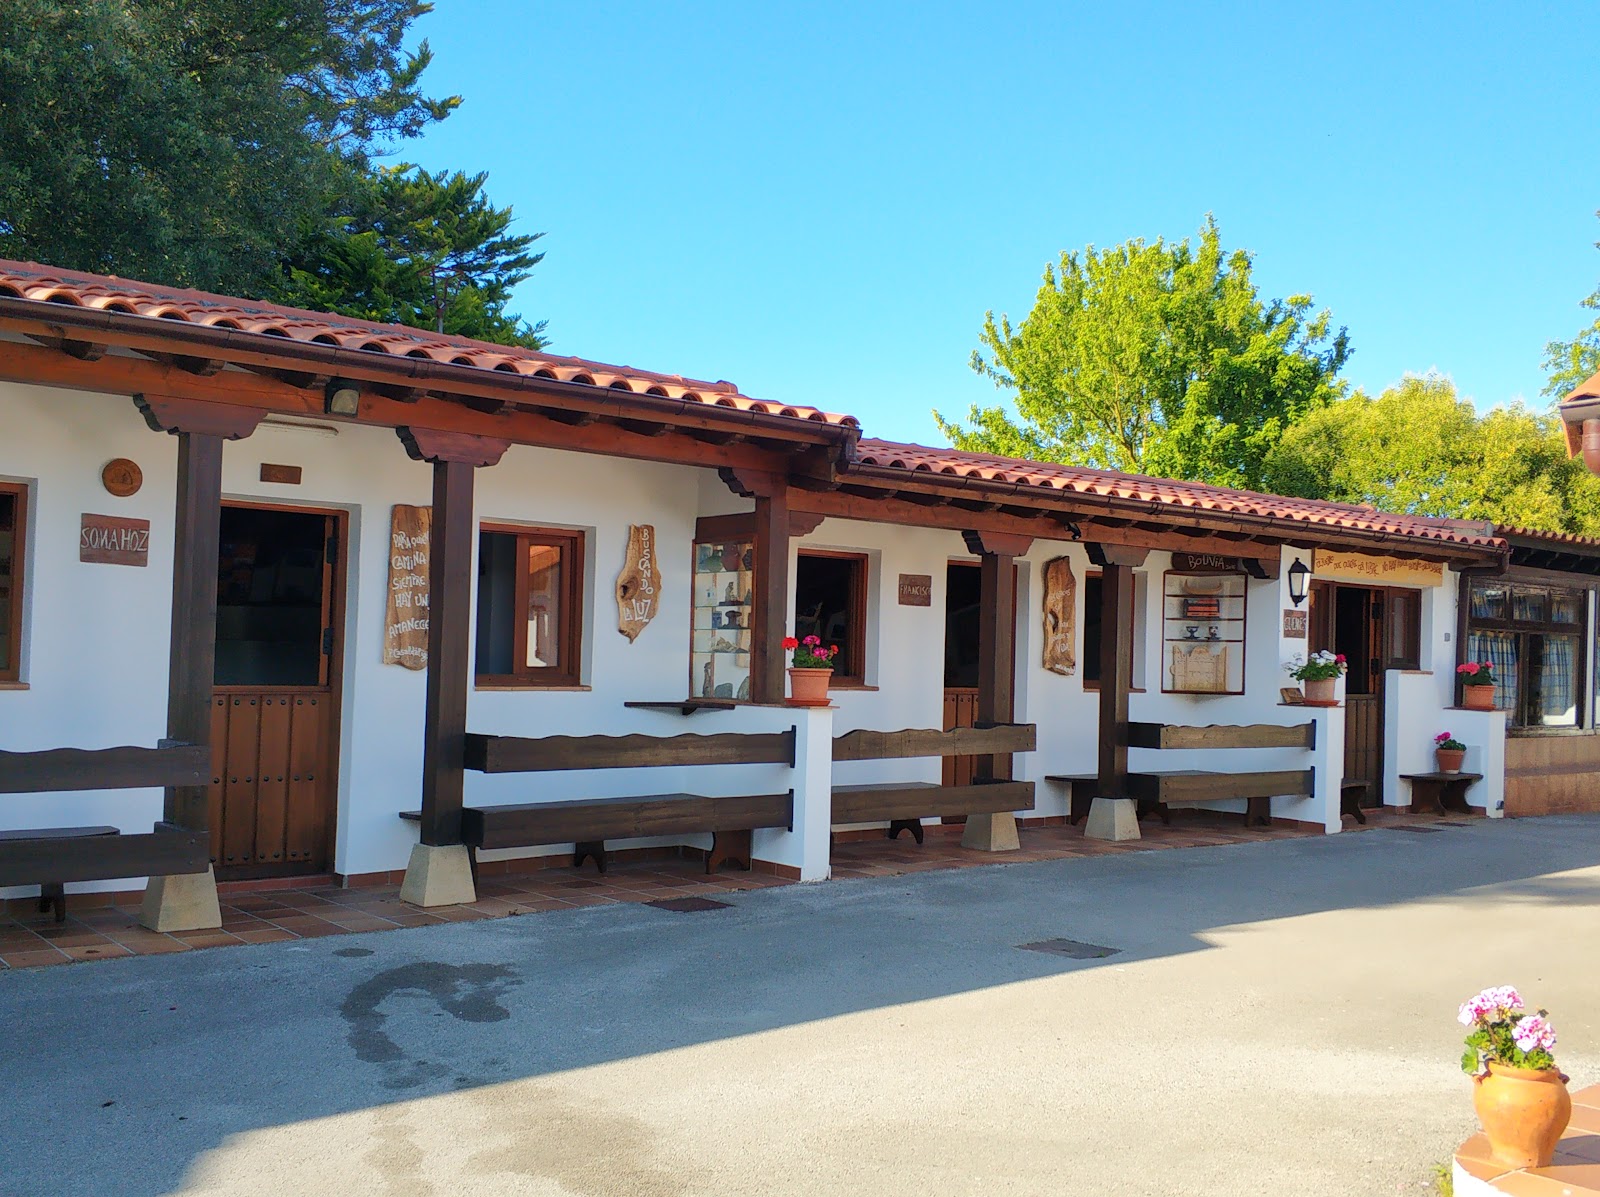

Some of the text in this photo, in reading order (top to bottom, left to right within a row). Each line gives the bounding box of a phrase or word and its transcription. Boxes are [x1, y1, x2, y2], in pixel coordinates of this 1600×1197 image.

[392, 531, 412, 550] PARA
[391, 550, 427, 571] CAMINA
[638, 528, 654, 595] BUSCANDO
[392, 573, 426, 590] SIEMPRE
[394, 591, 412, 608] HAY
[632, 598, 651, 623] LUZ
[389, 618, 430, 639] AMANECE
